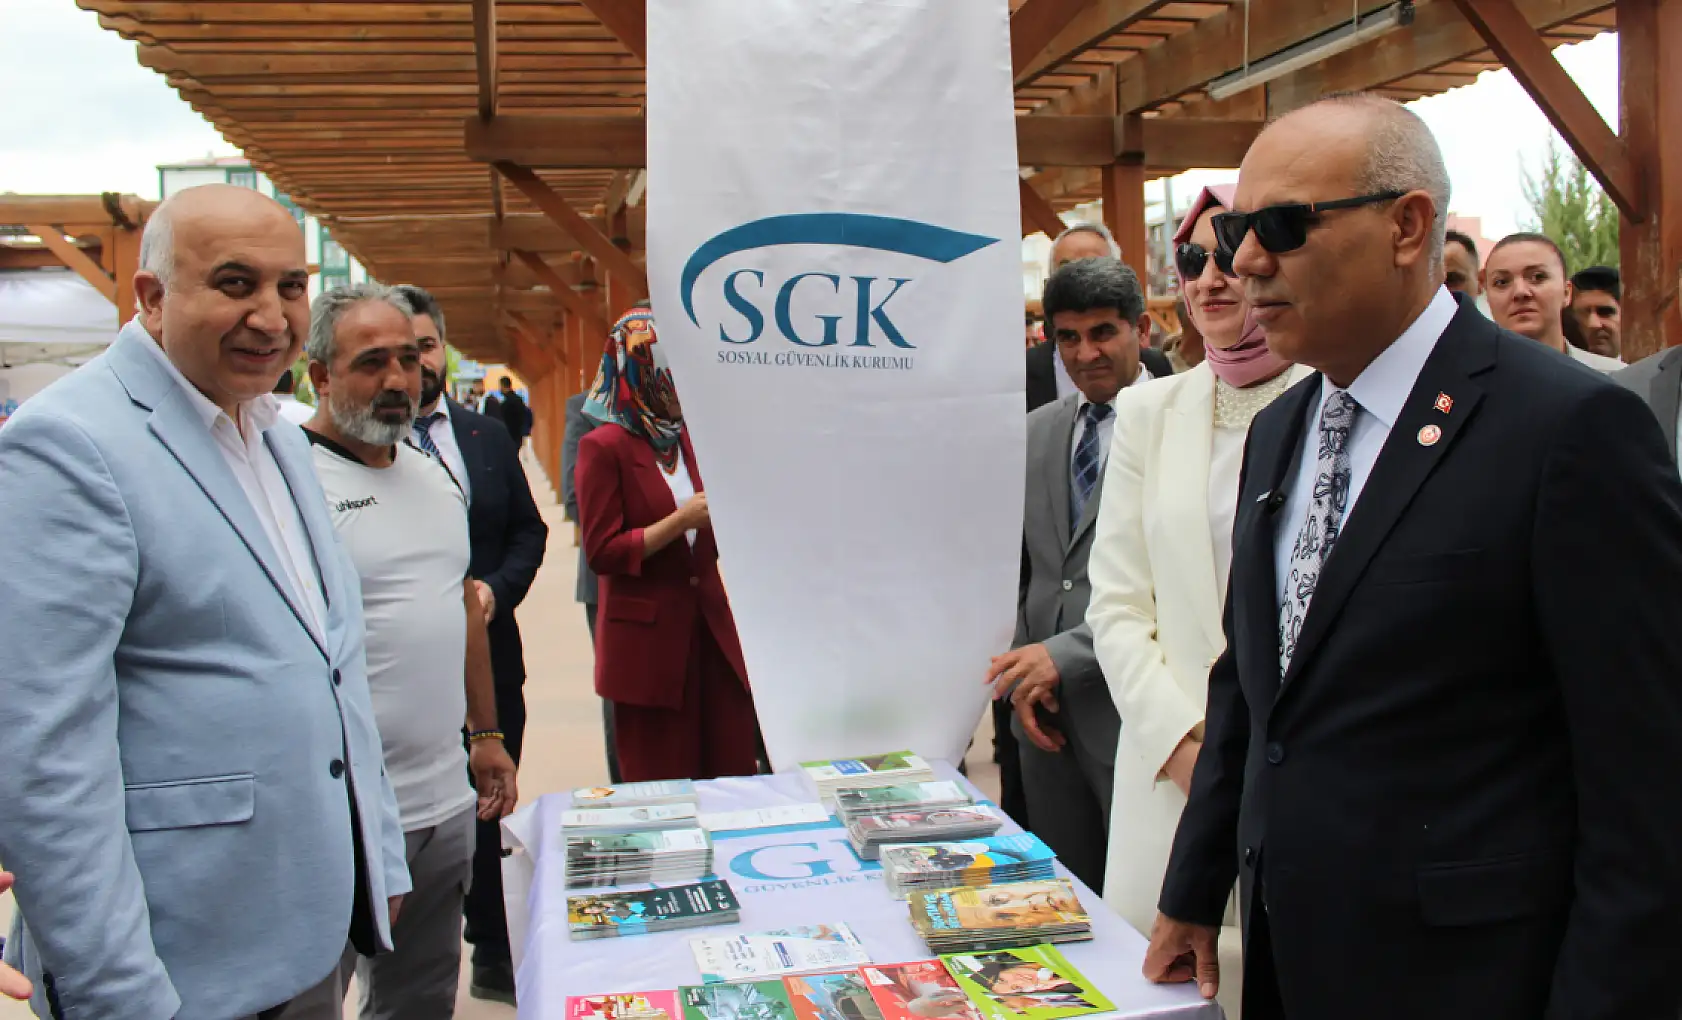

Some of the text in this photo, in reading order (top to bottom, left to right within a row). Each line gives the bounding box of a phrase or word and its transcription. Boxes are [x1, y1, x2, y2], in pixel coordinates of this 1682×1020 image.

[719, 268, 917, 349] SGK
[717, 350, 914, 370] SOSYAL GÜVENLİK KURUMU
[335, 495, 379, 512] uhlsport
